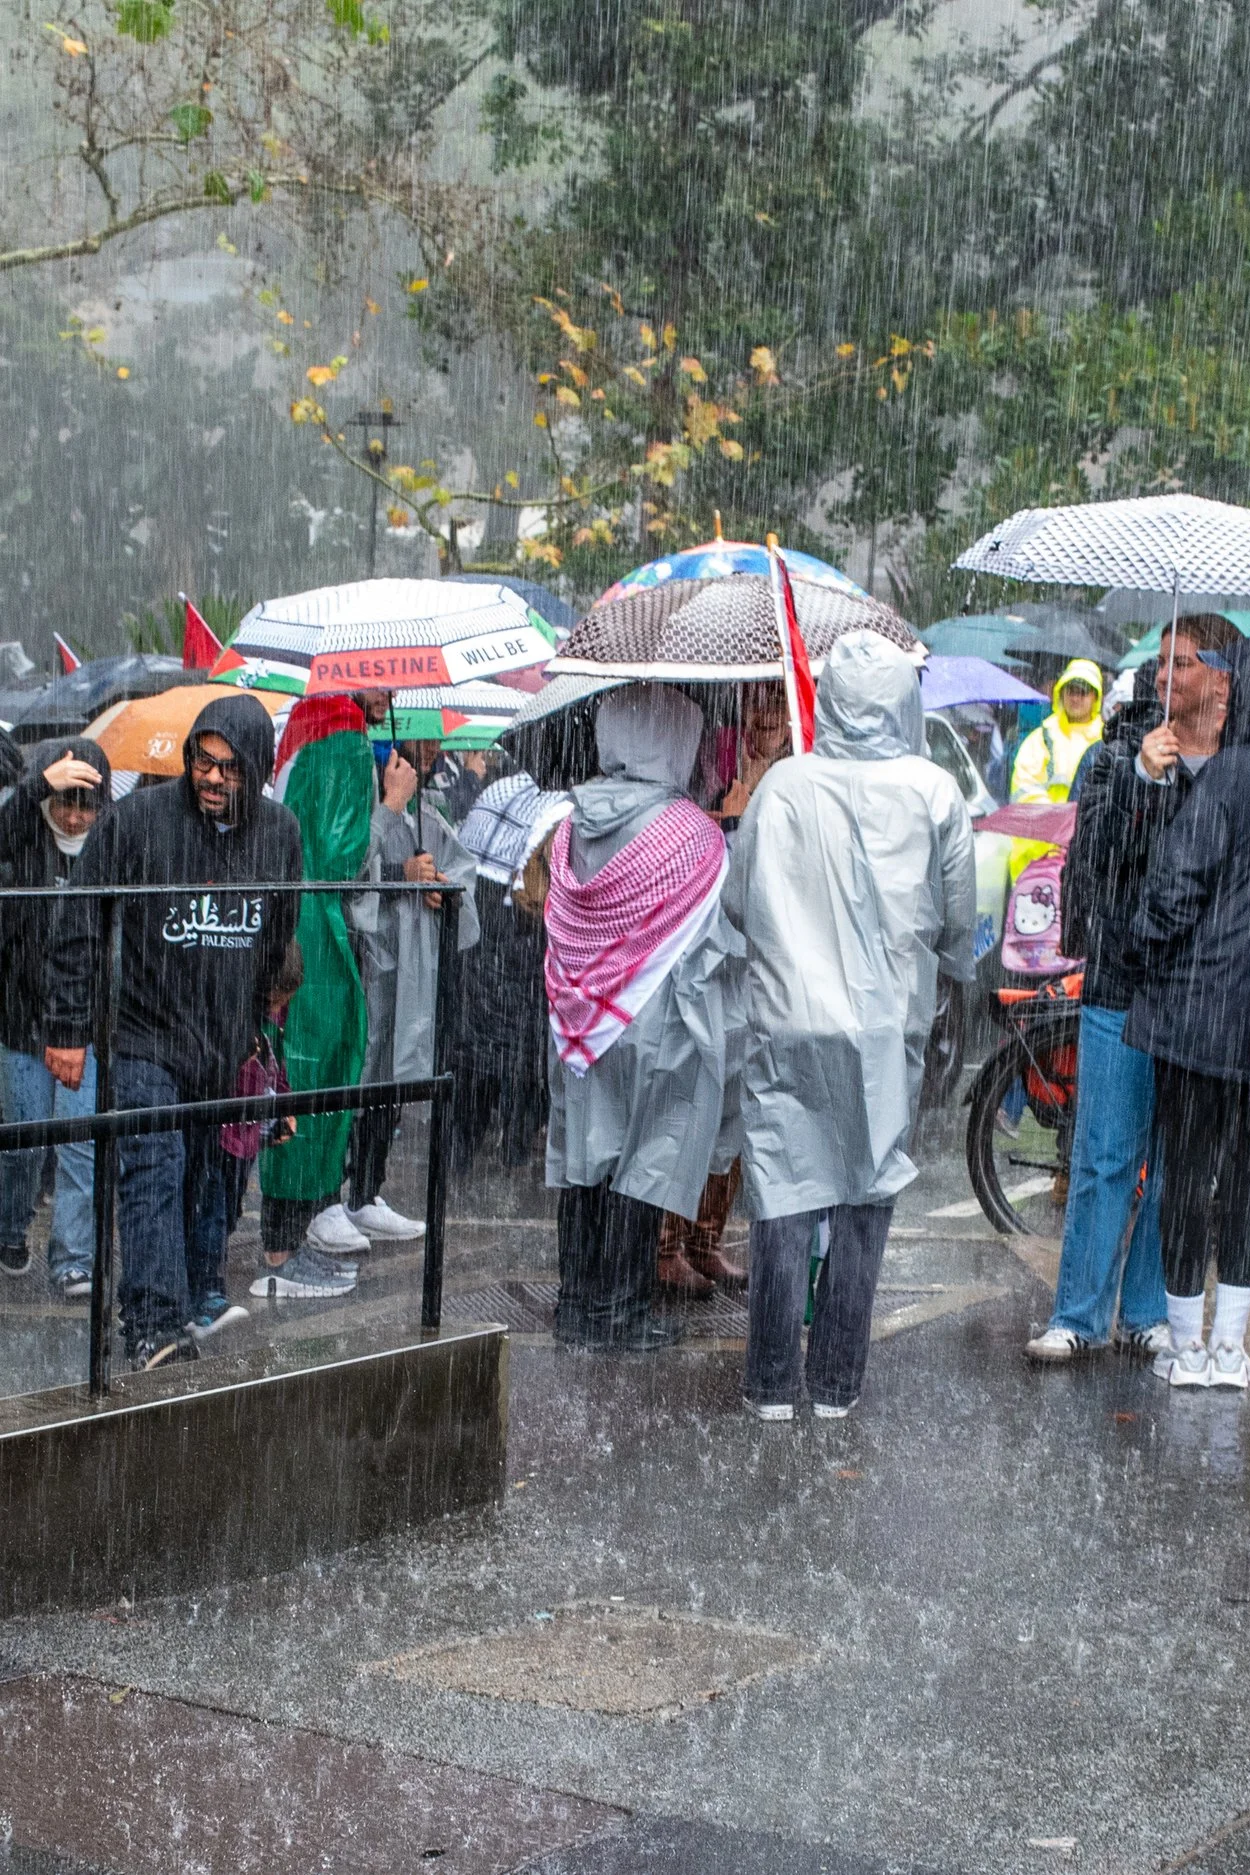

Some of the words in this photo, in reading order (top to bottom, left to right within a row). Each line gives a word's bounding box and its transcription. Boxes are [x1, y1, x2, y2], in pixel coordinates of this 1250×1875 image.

[317, 655, 438, 680] PALESTINE
[461, 644, 504, 666] WILL
[504, 638, 528, 656] BE
[201, 934, 254, 949] PALESTINE
